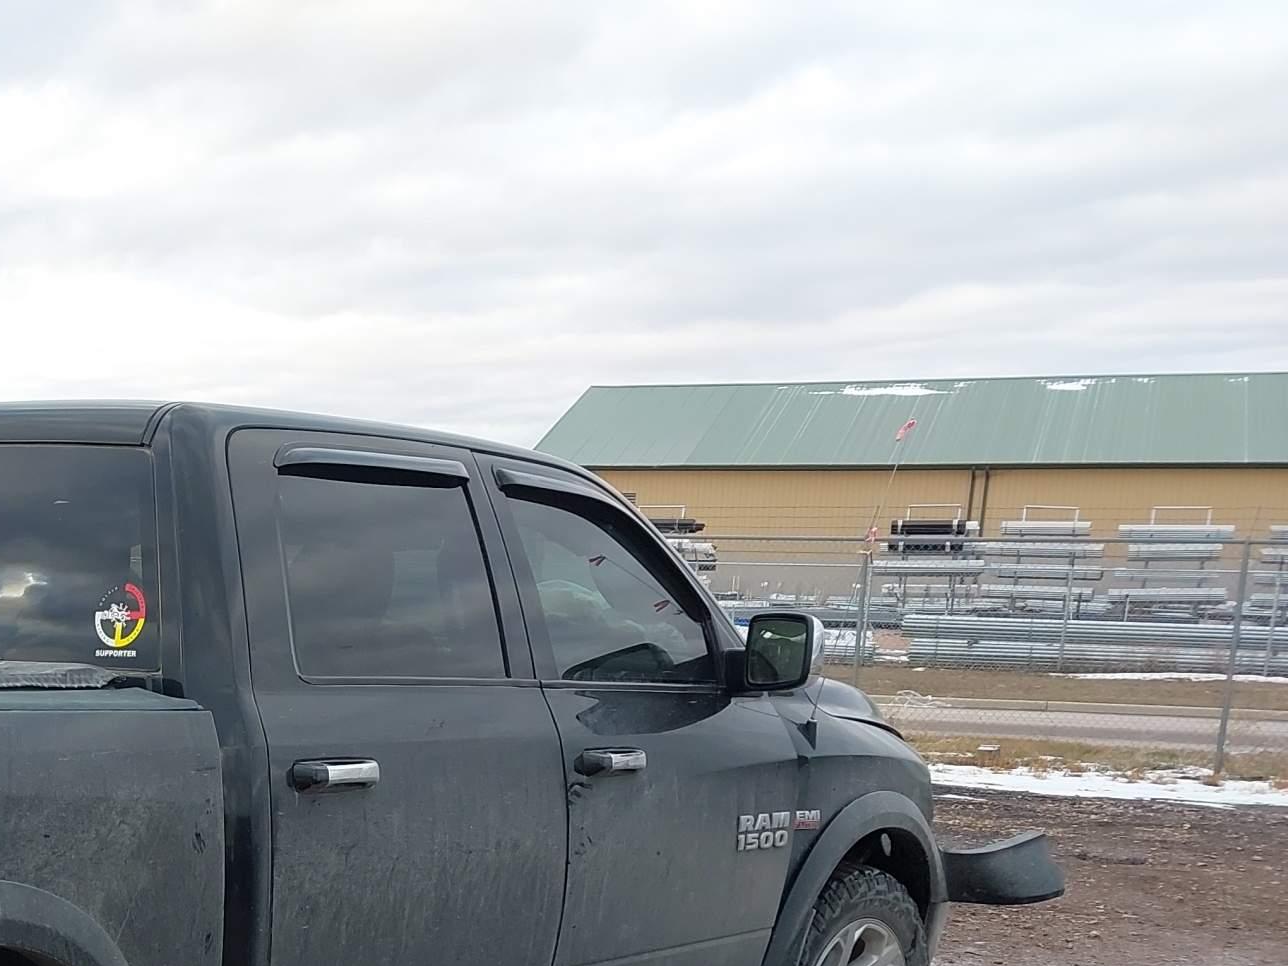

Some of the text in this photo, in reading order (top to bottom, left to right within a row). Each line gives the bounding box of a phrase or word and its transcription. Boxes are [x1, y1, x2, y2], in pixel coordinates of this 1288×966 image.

[95, 649, 137, 657] SUPPORTER
[738, 811, 791, 833] RAM
[737, 830, 789, 852] 1500
